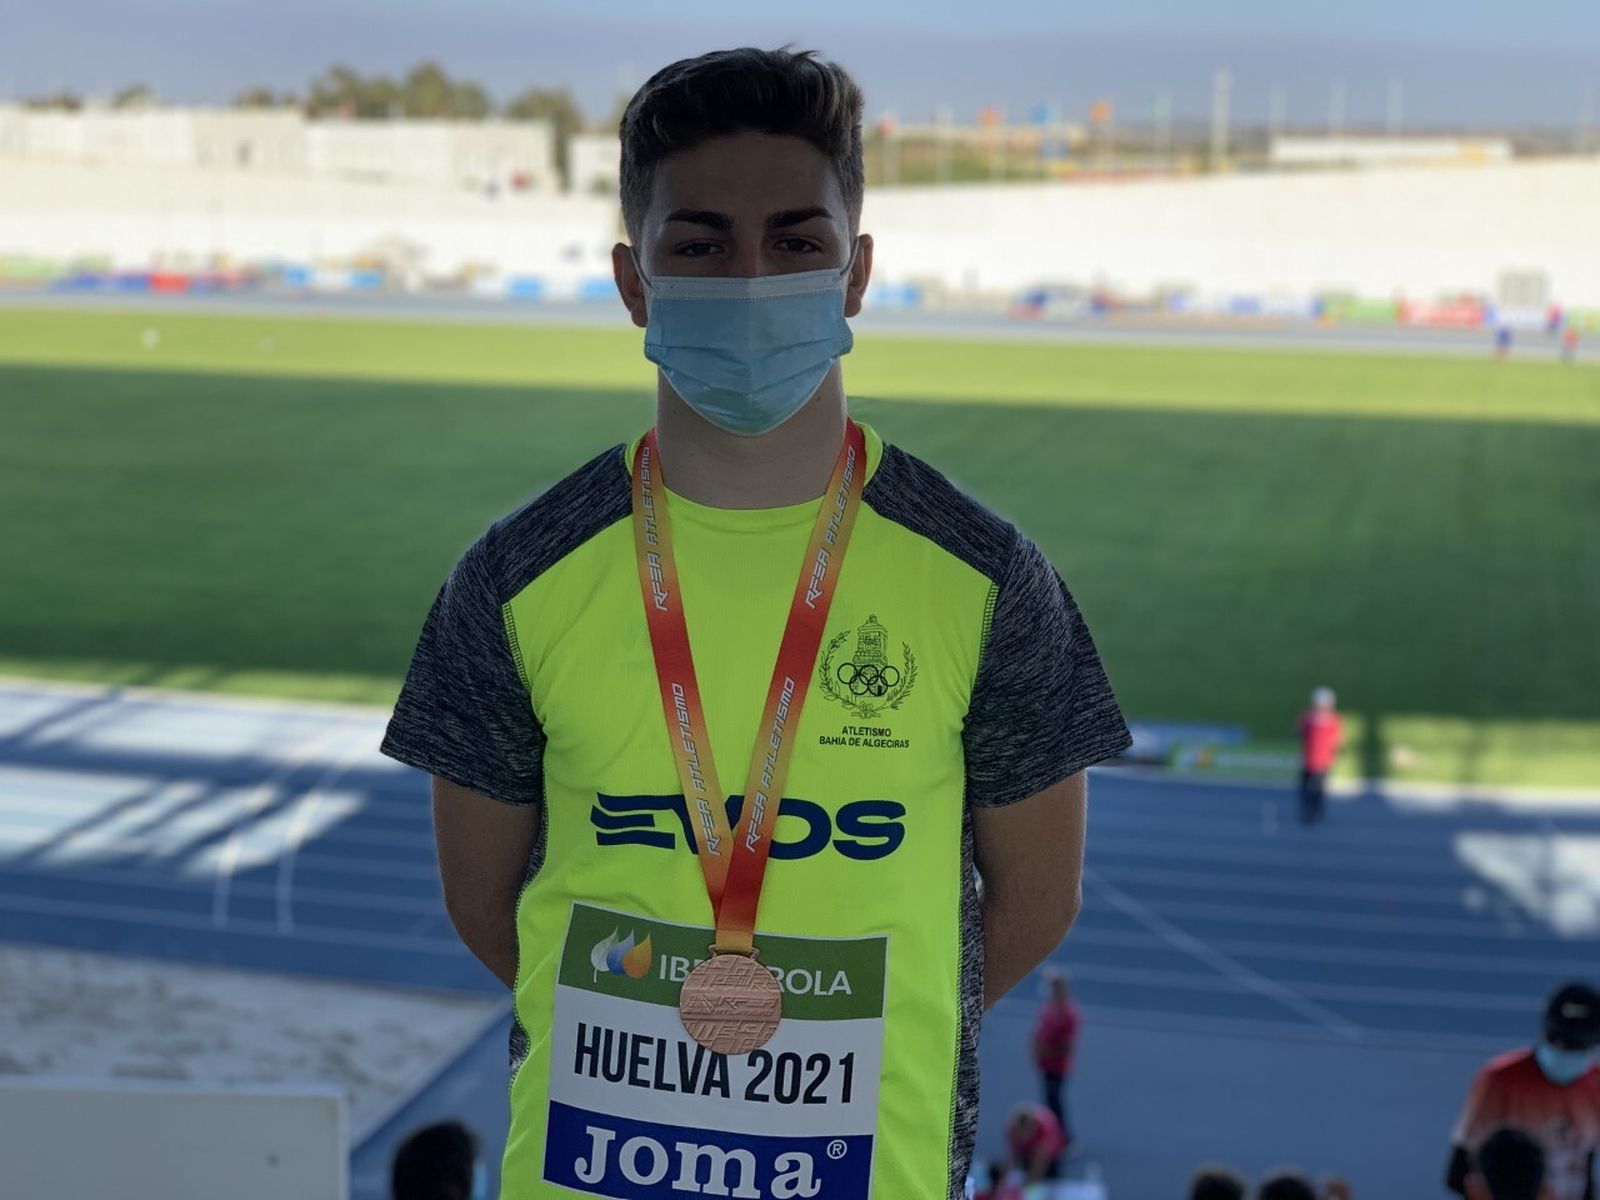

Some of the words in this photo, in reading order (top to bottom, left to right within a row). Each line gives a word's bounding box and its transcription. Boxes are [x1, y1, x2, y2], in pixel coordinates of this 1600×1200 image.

[642, 446, 658, 545] ATLETISMO
[825, 446, 855, 544] ATLETISMO
[672, 682, 706, 792] ATLETISMO
[761, 676, 796, 789] ATLETISMO
[819, 736, 846, 746] BAHIA
[848, 737, 860, 747] DE
[863, 738, 909, 748] ALGECIRAS
[842, 726, 891, 737] ATLETISMO
[659, 954, 852, 996] IBROLA
[574, 1022, 730, 1099] HUELVA
[744, 1050, 855, 1105] 2021
